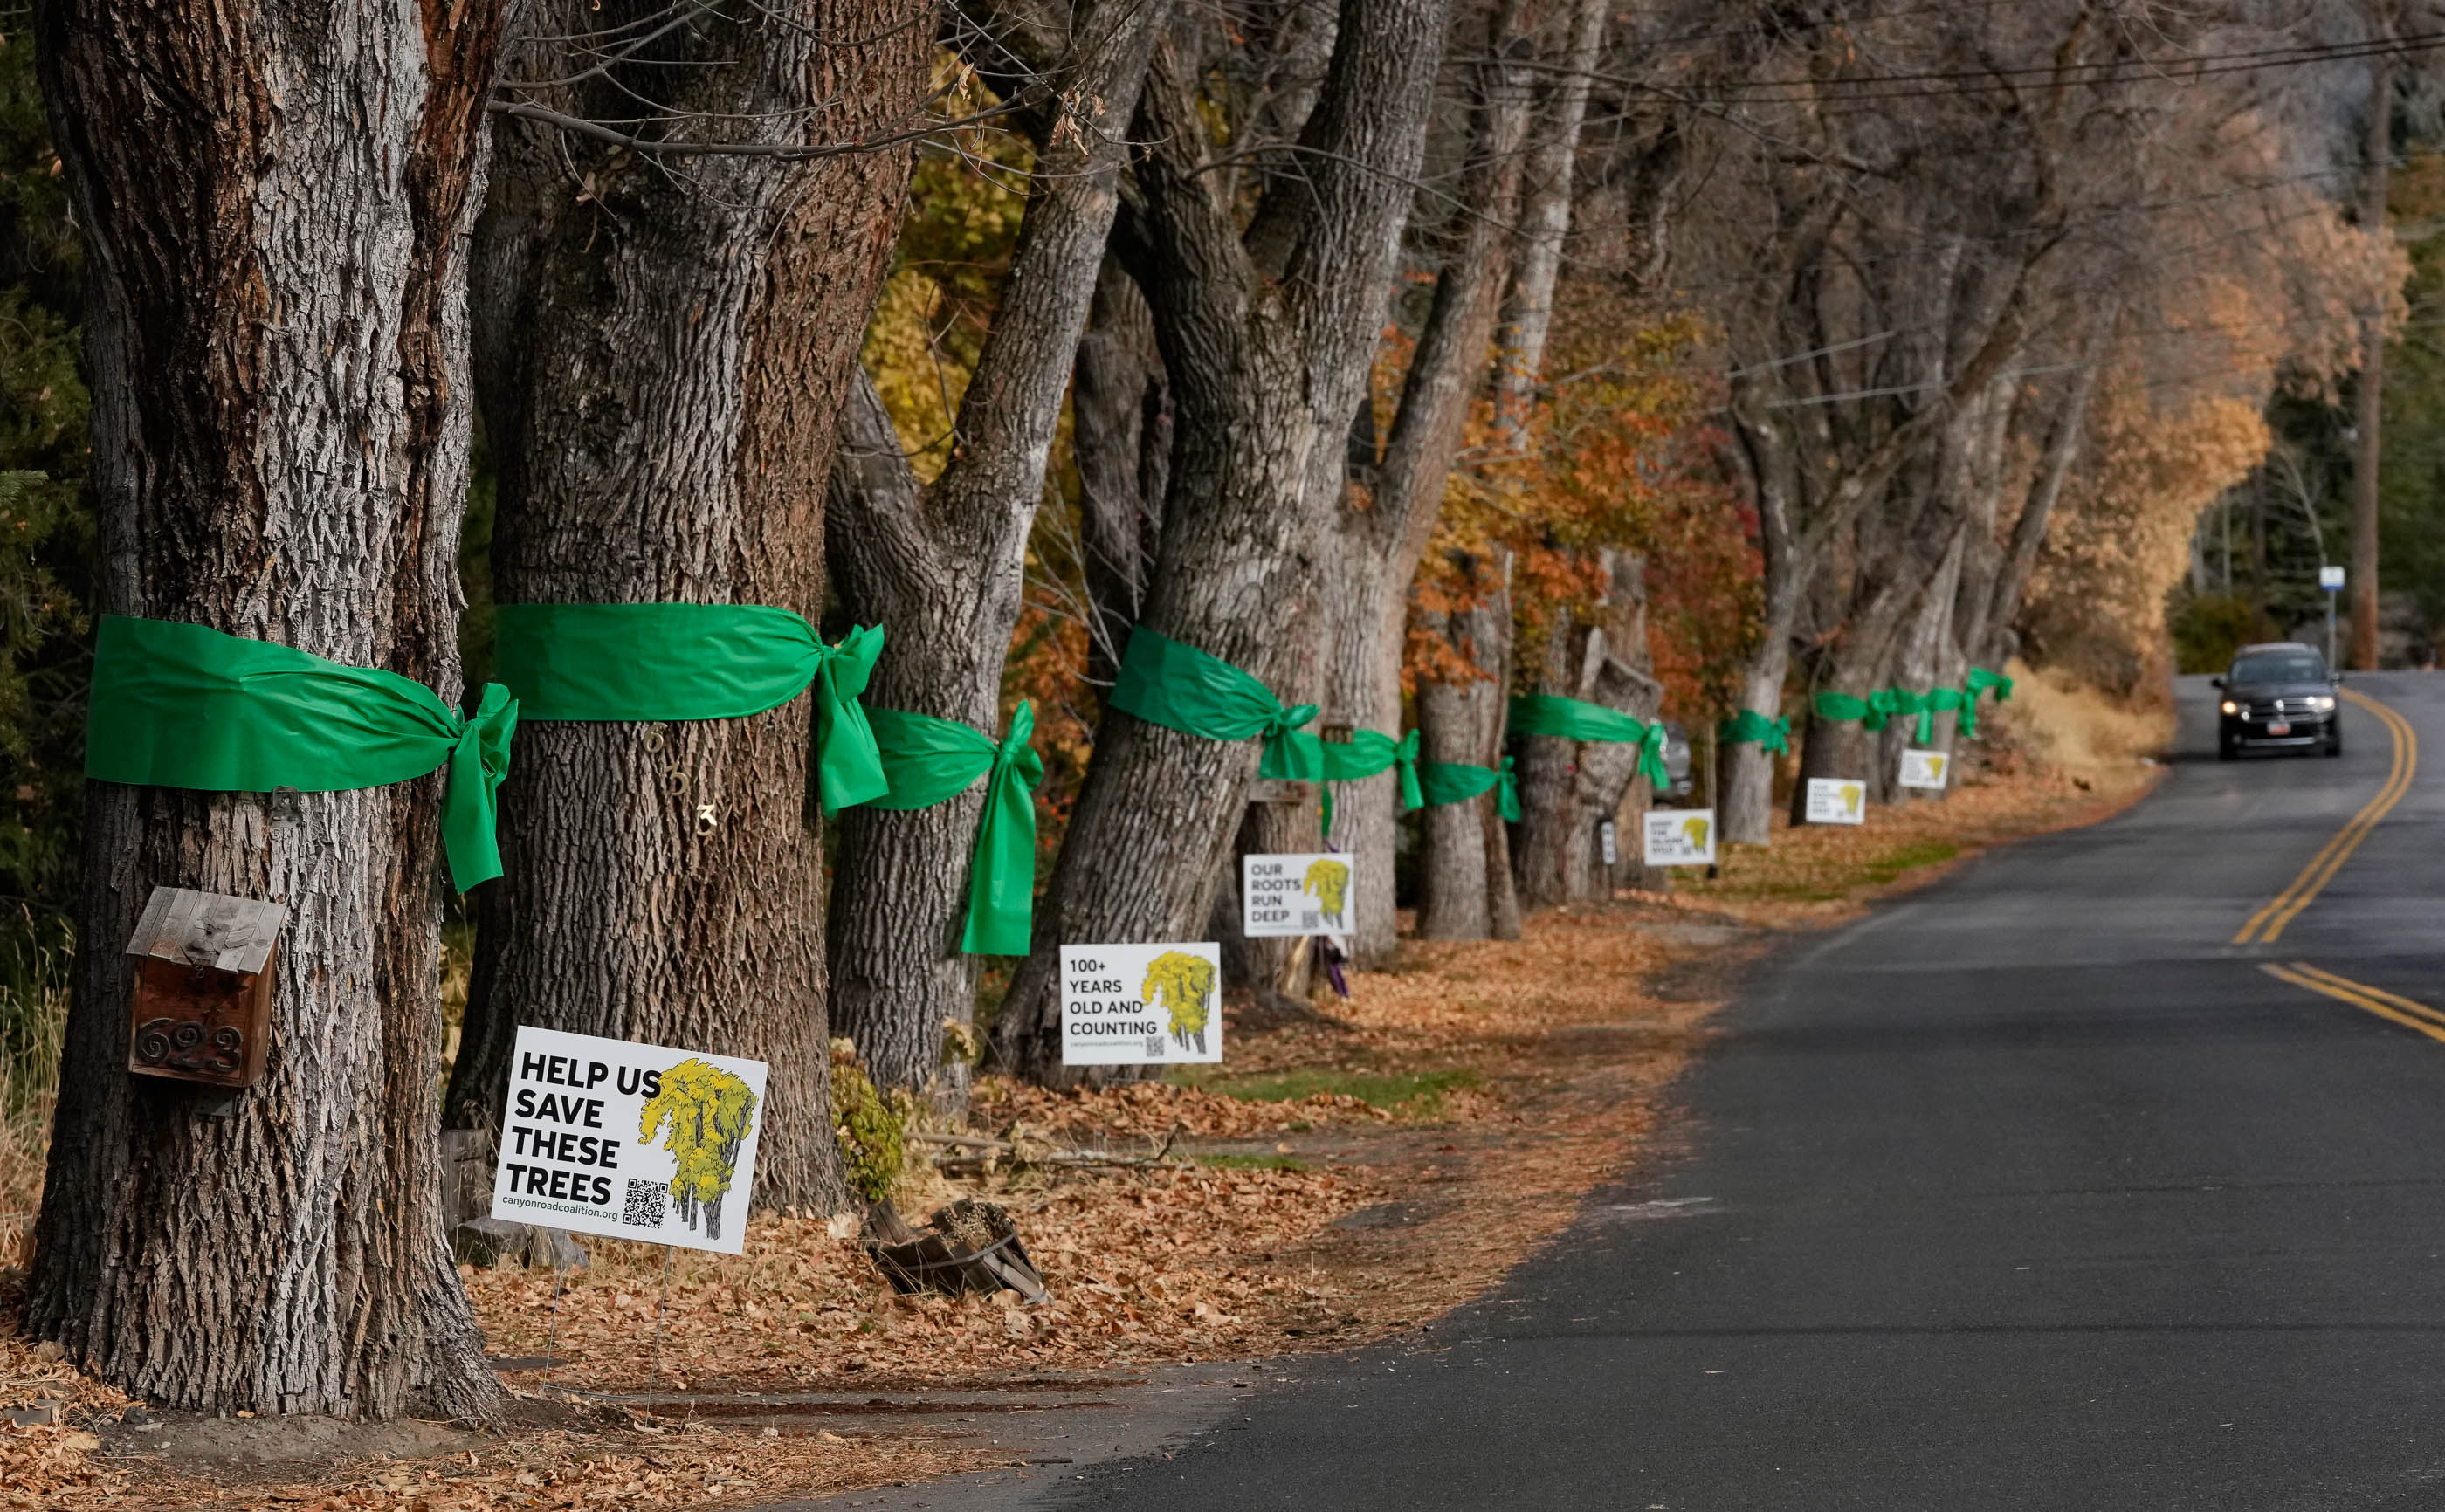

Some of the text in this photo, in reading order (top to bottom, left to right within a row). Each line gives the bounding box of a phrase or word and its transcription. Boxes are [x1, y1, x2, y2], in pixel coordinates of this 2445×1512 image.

[1250, 863, 1284, 876] OUR
[1250, 878, 1302, 891] ROOTS
[1250, 894, 1283, 907] RUN
[1250, 910, 1291, 924] DEEP
[1070, 959, 1106, 972] 100+
[1070, 979, 1123, 993] YEARS
[1070, 1000, 1144, 1014] OLD AND
[1070, 1021, 1158, 1035] COUNTING
[135, 1017, 243, 1073] 623
[520, 1051, 663, 1100] HELP US
[513, 1089, 606, 1130] SAVE
[511, 1125, 622, 1170] THESE
[506, 1163, 613, 1206] TREES
[502, 1195, 618, 1222] canyonroadcoalition.org
